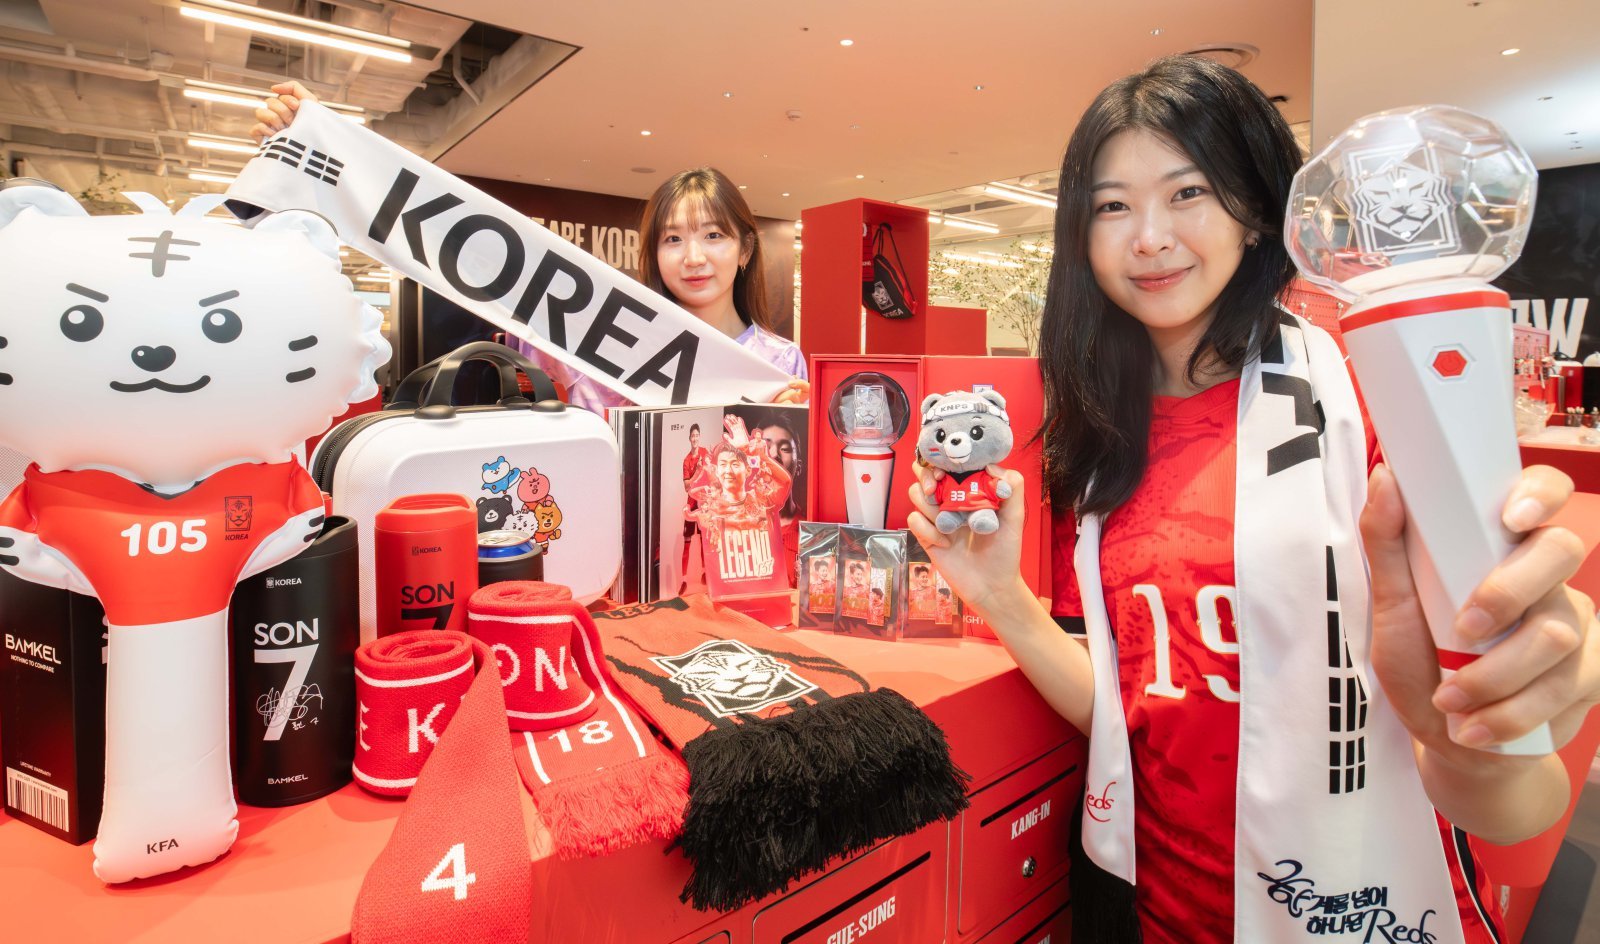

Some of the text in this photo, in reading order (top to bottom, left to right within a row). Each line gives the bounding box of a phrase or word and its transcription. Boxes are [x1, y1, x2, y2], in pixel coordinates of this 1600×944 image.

[367, 167, 700, 405] KOREA
[940, 402, 969, 413] KNPS
[950, 490, 966, 502] 33
[120, 518, 208, 557] 105
[225, 533, 249, 541] KOREA
[419, 546, 442, 555] KOREA
[718, 528, 773, 580] LEGEND
[275, 577, 303, 586] KOREA
[401, 580, 454, 606] SON
[254, 617, 319, 647] SON
[1131, 584, 1240, 703] 19
[5, 633, 62, 665] BAMKEL
[11, 654, 28, 665] NOTHING
[34, 662, 55, 674] COMPARE
[254, 643, 320, 741] 7
[549, 720, 613, 753] 18
[267, 774, 309, 785] BAMKEL
[1086, 781, 1117, 823] eds
[1011, 799, 1051, 840] KANG-IN
[147, 838, 179, 855] KFA
[421, 841, 477, 901] 4
[827, 896, 896, 944] GUE-SUNG
[1360, 907, 1438, 944] Reds
